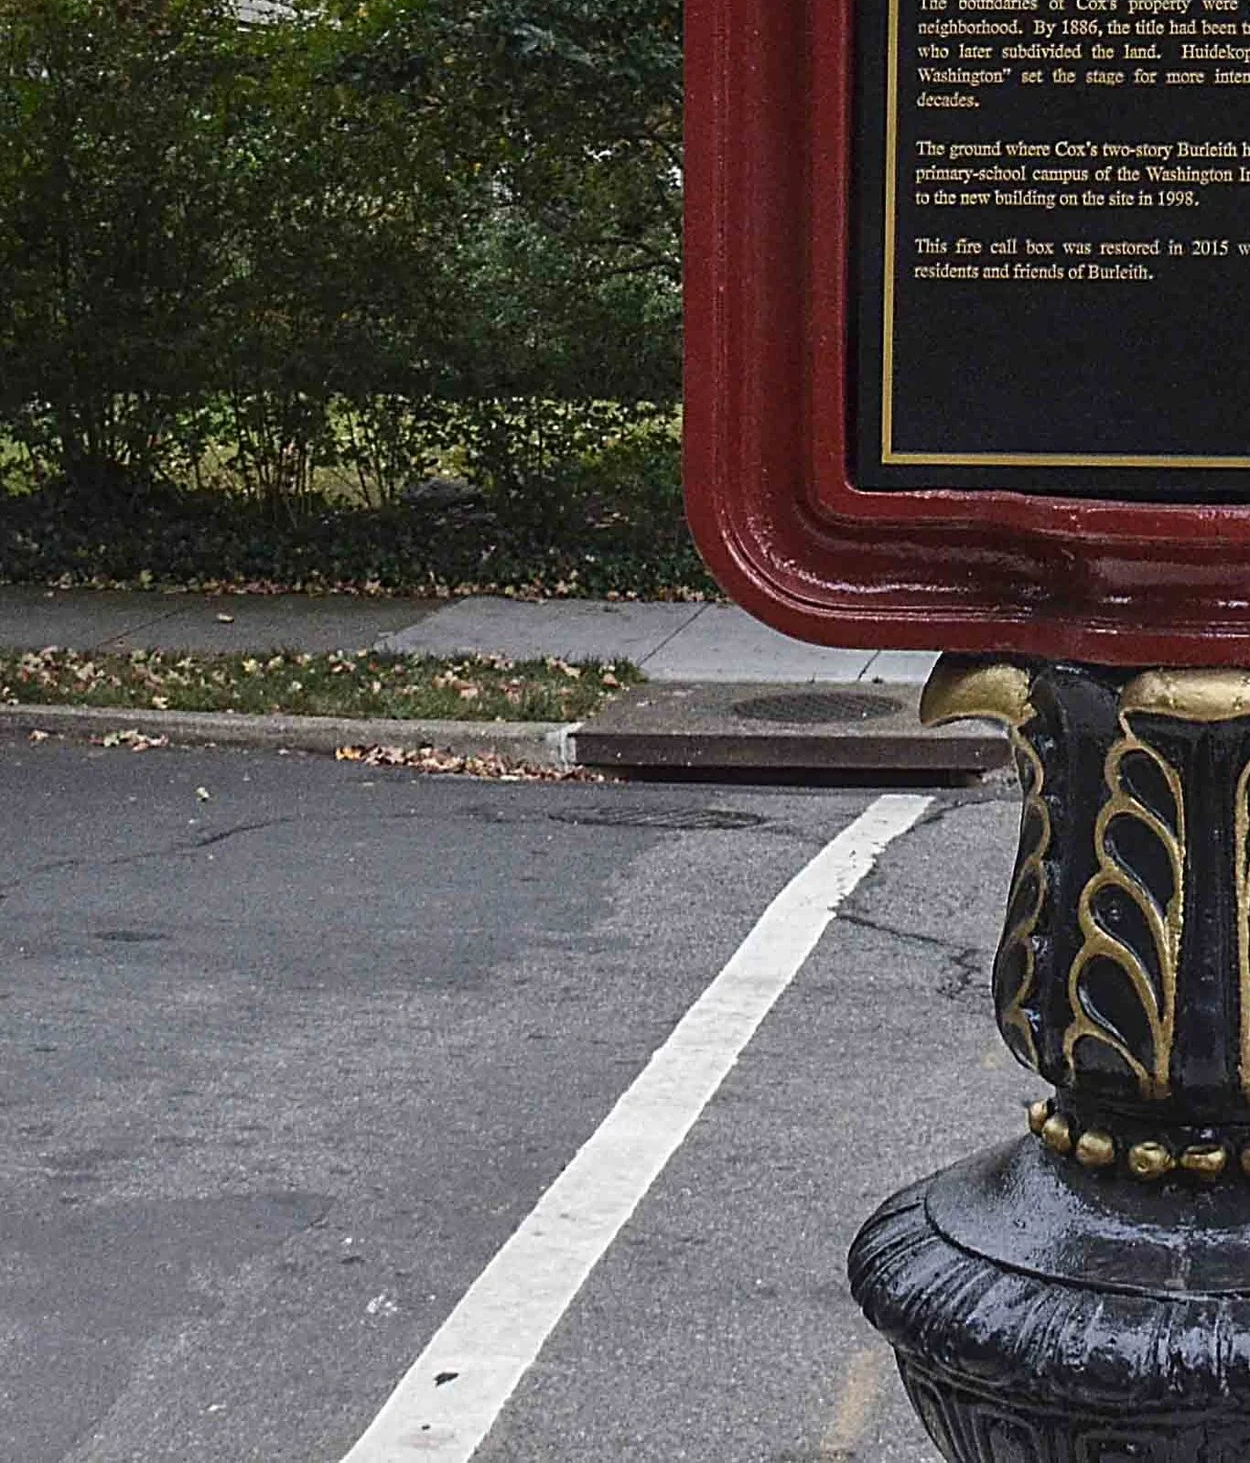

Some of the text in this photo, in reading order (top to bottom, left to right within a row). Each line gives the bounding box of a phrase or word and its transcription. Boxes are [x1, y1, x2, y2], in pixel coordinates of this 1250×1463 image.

[918, 19, 1023, 38] neighborhood.
[1034, 20, 1056, 38] By
[1062, 19, 1103, 37] 1886,
[1107, 20, 1130, 34] the
[1135, 20, 1164, 35] title
[1169, 19, 1197, 34] had
[1202, 20, 1236, 35] been
[917, 92, 979, 107] decades.
[916, 165, 1025, 184] primary-school
[1033, 169, 1088, 184] campus
[1095, 166, 1112, 181] of
[1117, 166, 1140, 181] the
[1146, 166, 1233, 185] Washington
[916, 190, 1199, 209] to the new building on the site in 1998.
[915, 238, 947, 253] This
[956, 238, 981, 253] fire
[991, 239, 1017, 254] call
[1026, 239, 1053, 254] box
[1063, 243, 1091, 254] was
[1101, 240, 1160, 255] restored
[1169, 240, 1182, 255] in
[1193, 240, 1228, 255] 2015
